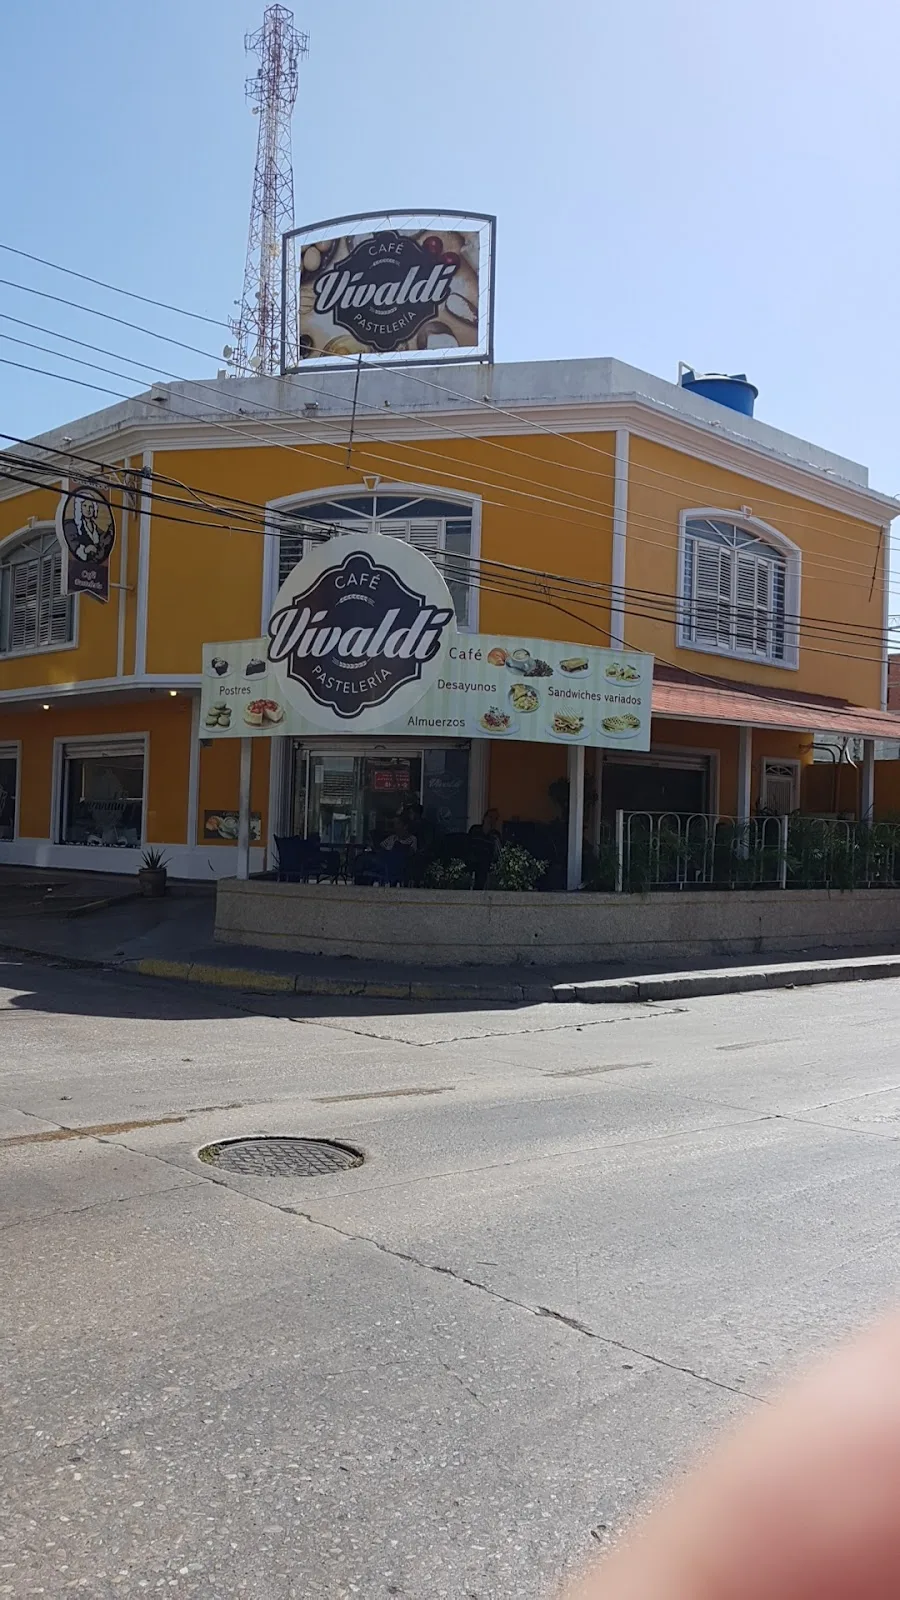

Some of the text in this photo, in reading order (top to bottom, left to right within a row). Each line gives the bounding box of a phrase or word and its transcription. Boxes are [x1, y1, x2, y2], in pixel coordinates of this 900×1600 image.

[368, 242, 405, 256] CAFÉ
[314, 264, 457, 312] Vivaldi
[353, 310, 417, 335] PASTELERÍA
[334, 573, 382, 591] CAFÉ
[269, 607, 451, 660] Vivaldi
[449, 647, 482, 661] Café
[311, 664, 393, 695] PASTELERÍA
[437, 678, 497, 693] Desayunos
[219, 685, 252, 696] Postres
[547, 686, 642, 706] Sandwiches variados
[407, 715, 466, 728] Almuerzos
